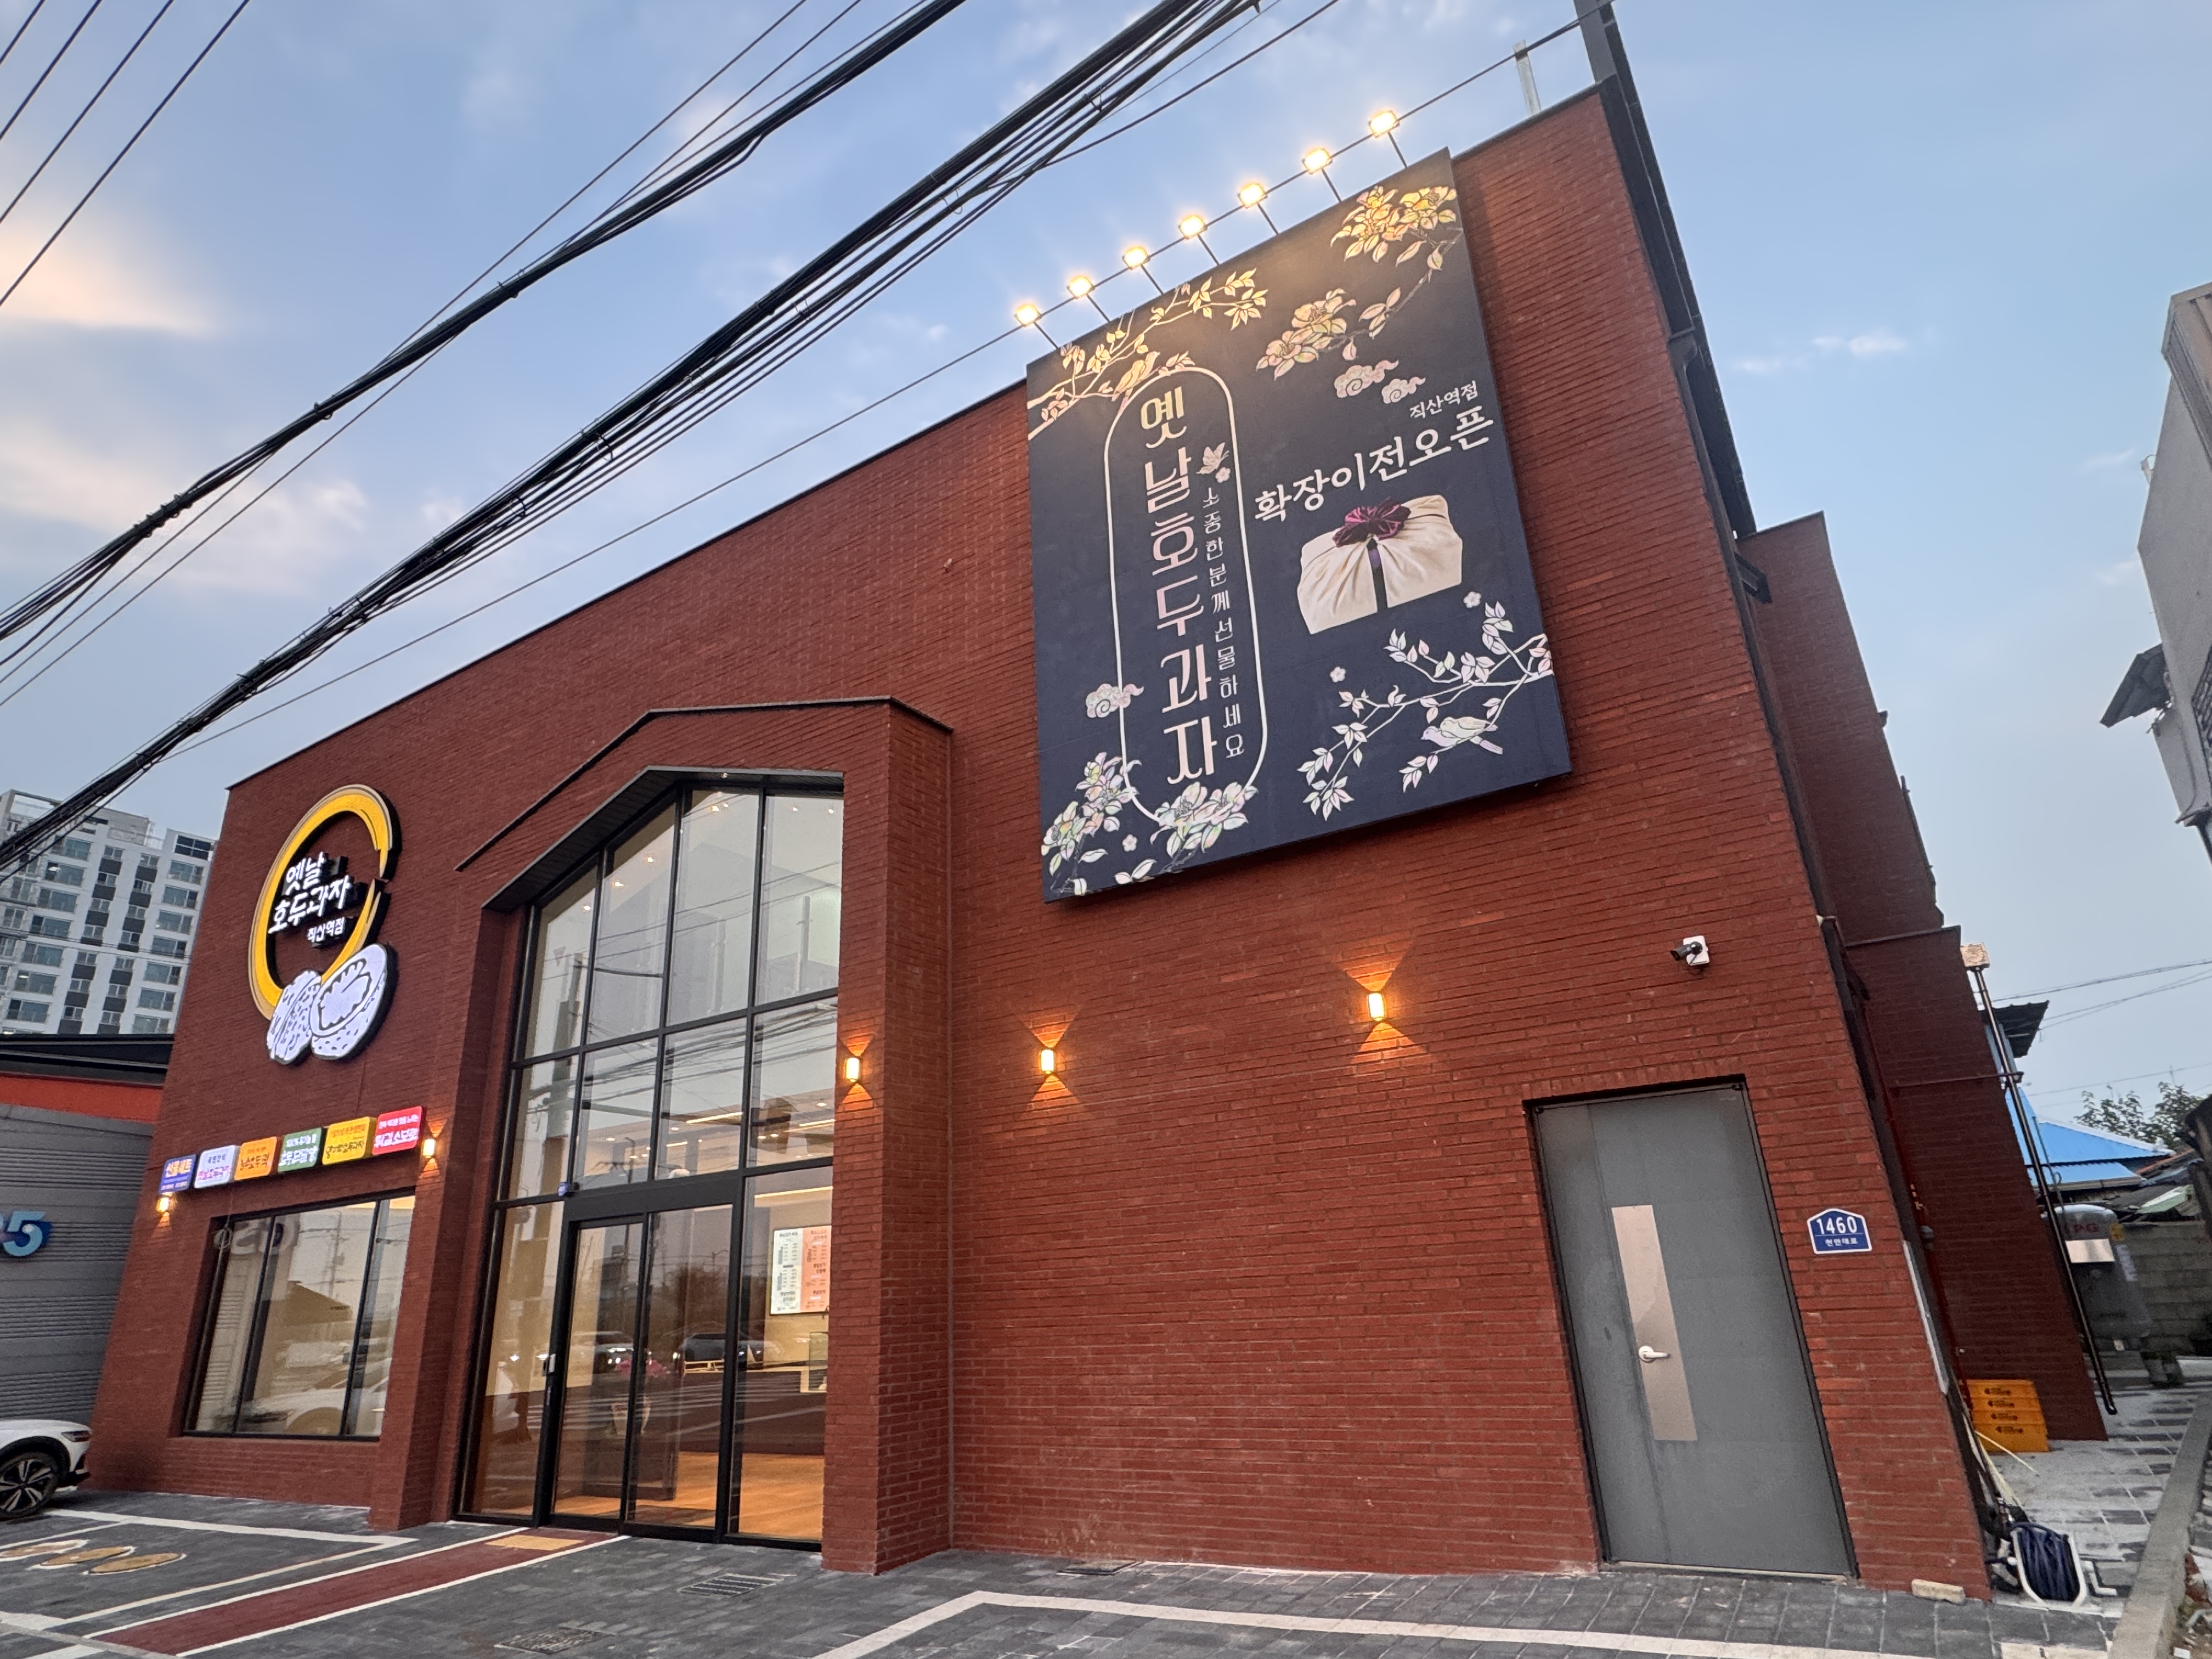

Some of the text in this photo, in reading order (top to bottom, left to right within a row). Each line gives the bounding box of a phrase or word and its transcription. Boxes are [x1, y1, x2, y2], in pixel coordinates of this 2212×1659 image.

[1409, 380, 1479, 419] 직산역점
[1254, 405, 1493, 521] 확장이전오픈
[1139, 384, 1216, 786] 옛날호두과자
[285, 851, 325, 895] 옛날
[268, 875, 352, 934] 호두과자
[307, 917, 345, 943] 직산역점
[0, 1211, 46, 1256] 5
[1816, 1216, 1858, 1234] 1460
